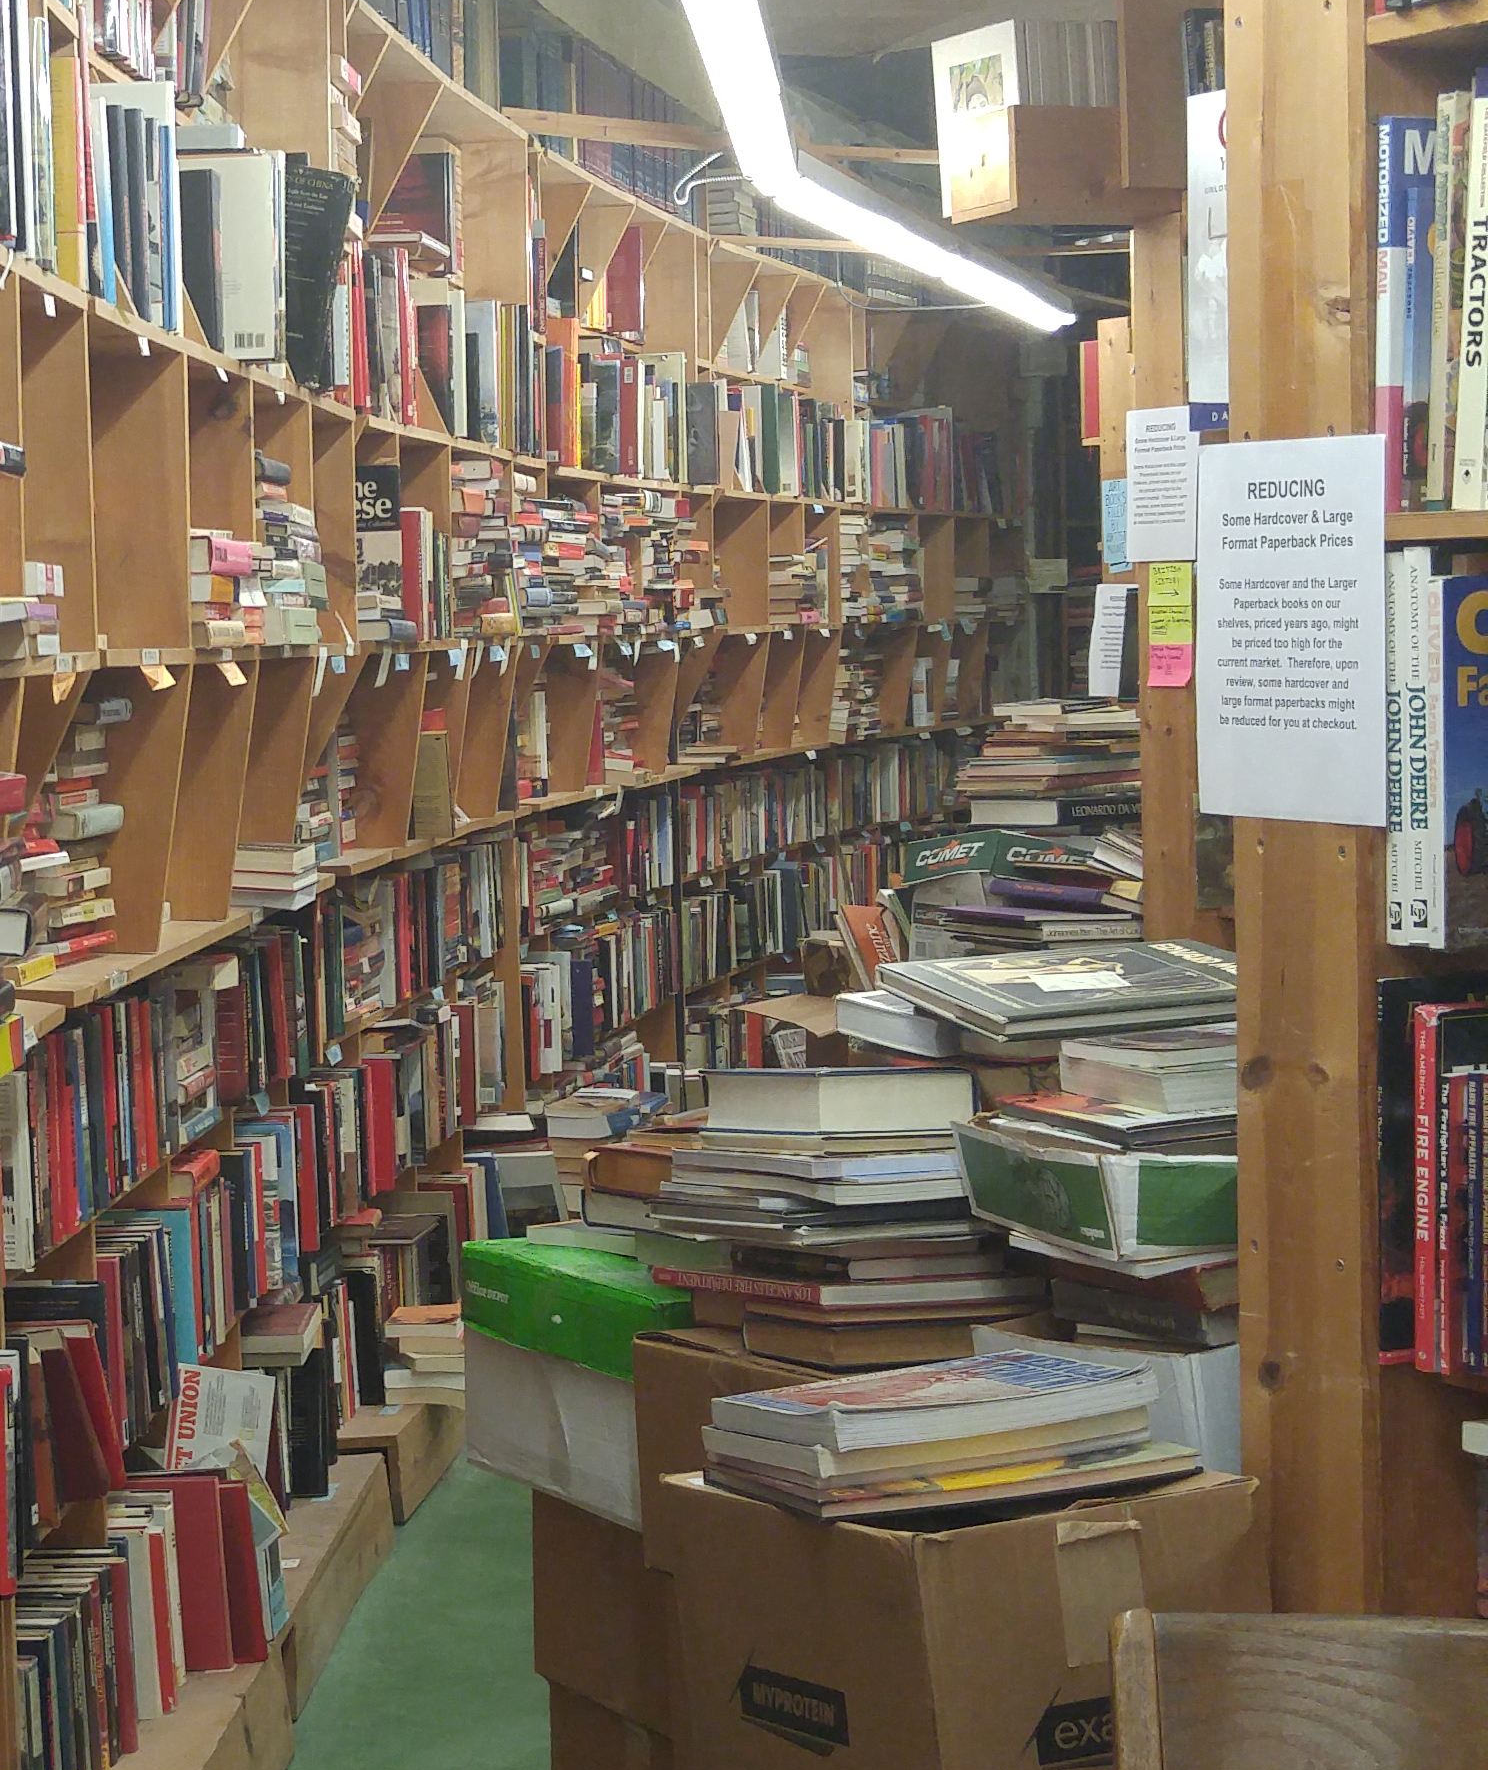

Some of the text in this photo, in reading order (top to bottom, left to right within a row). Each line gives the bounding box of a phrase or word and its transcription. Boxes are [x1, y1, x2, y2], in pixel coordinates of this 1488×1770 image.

[1376, 124, 1392, 298] MOTORIZED MAIL
[1465, 217, 1486, 368] TRACTORS
[1247, 478, 1325, 500] REDUCING
[1222, 510, 1353, 526] Some Hardcover & Large
[1222, 533, 1354, 551] Format Paperback Prices
[1219, 577, 1357, 591] Some Hardcover and the Larger
[1233, 597, 1341, 611] Paperback books on our
[1410, 565, 1420, 632] ANATOMY
[1217, 617, 1359, 631] shelves, priced years ago, might
[1231, 637, 1343, 651] be priced too high for the
[1217, 657, 1359, 672] current market. Therefore, upon
[1226, 676, 1349, 689] review, some hardcover and
[1221, 695, 1355, 712] large format paperbacks might
[1219, 714, 1357, 730] be reduced for you at checkout.
[1387, 688, 1402, 755] JOHN
[1405, 682, 1427, 750] JOHN
[1388, 758, 1403, 835] DEERE
[1410, 752, 1429, 831] DEERE
[1071, 804, 1115, 818] LEONARDO
[1118, 803, 1130, 816] DA
[915, 842, 985, 868] COMET
[1440, 1083, 1449, 1104] The
[1416, 1030, 1430, 1242] THE AMERICAN FIRE ENGINE
[794, 1286, 811, 1302] LOS
[177, 1369, 201, 1440] UNION
[752, 1681, 836, 1727] MYPROTEIN
